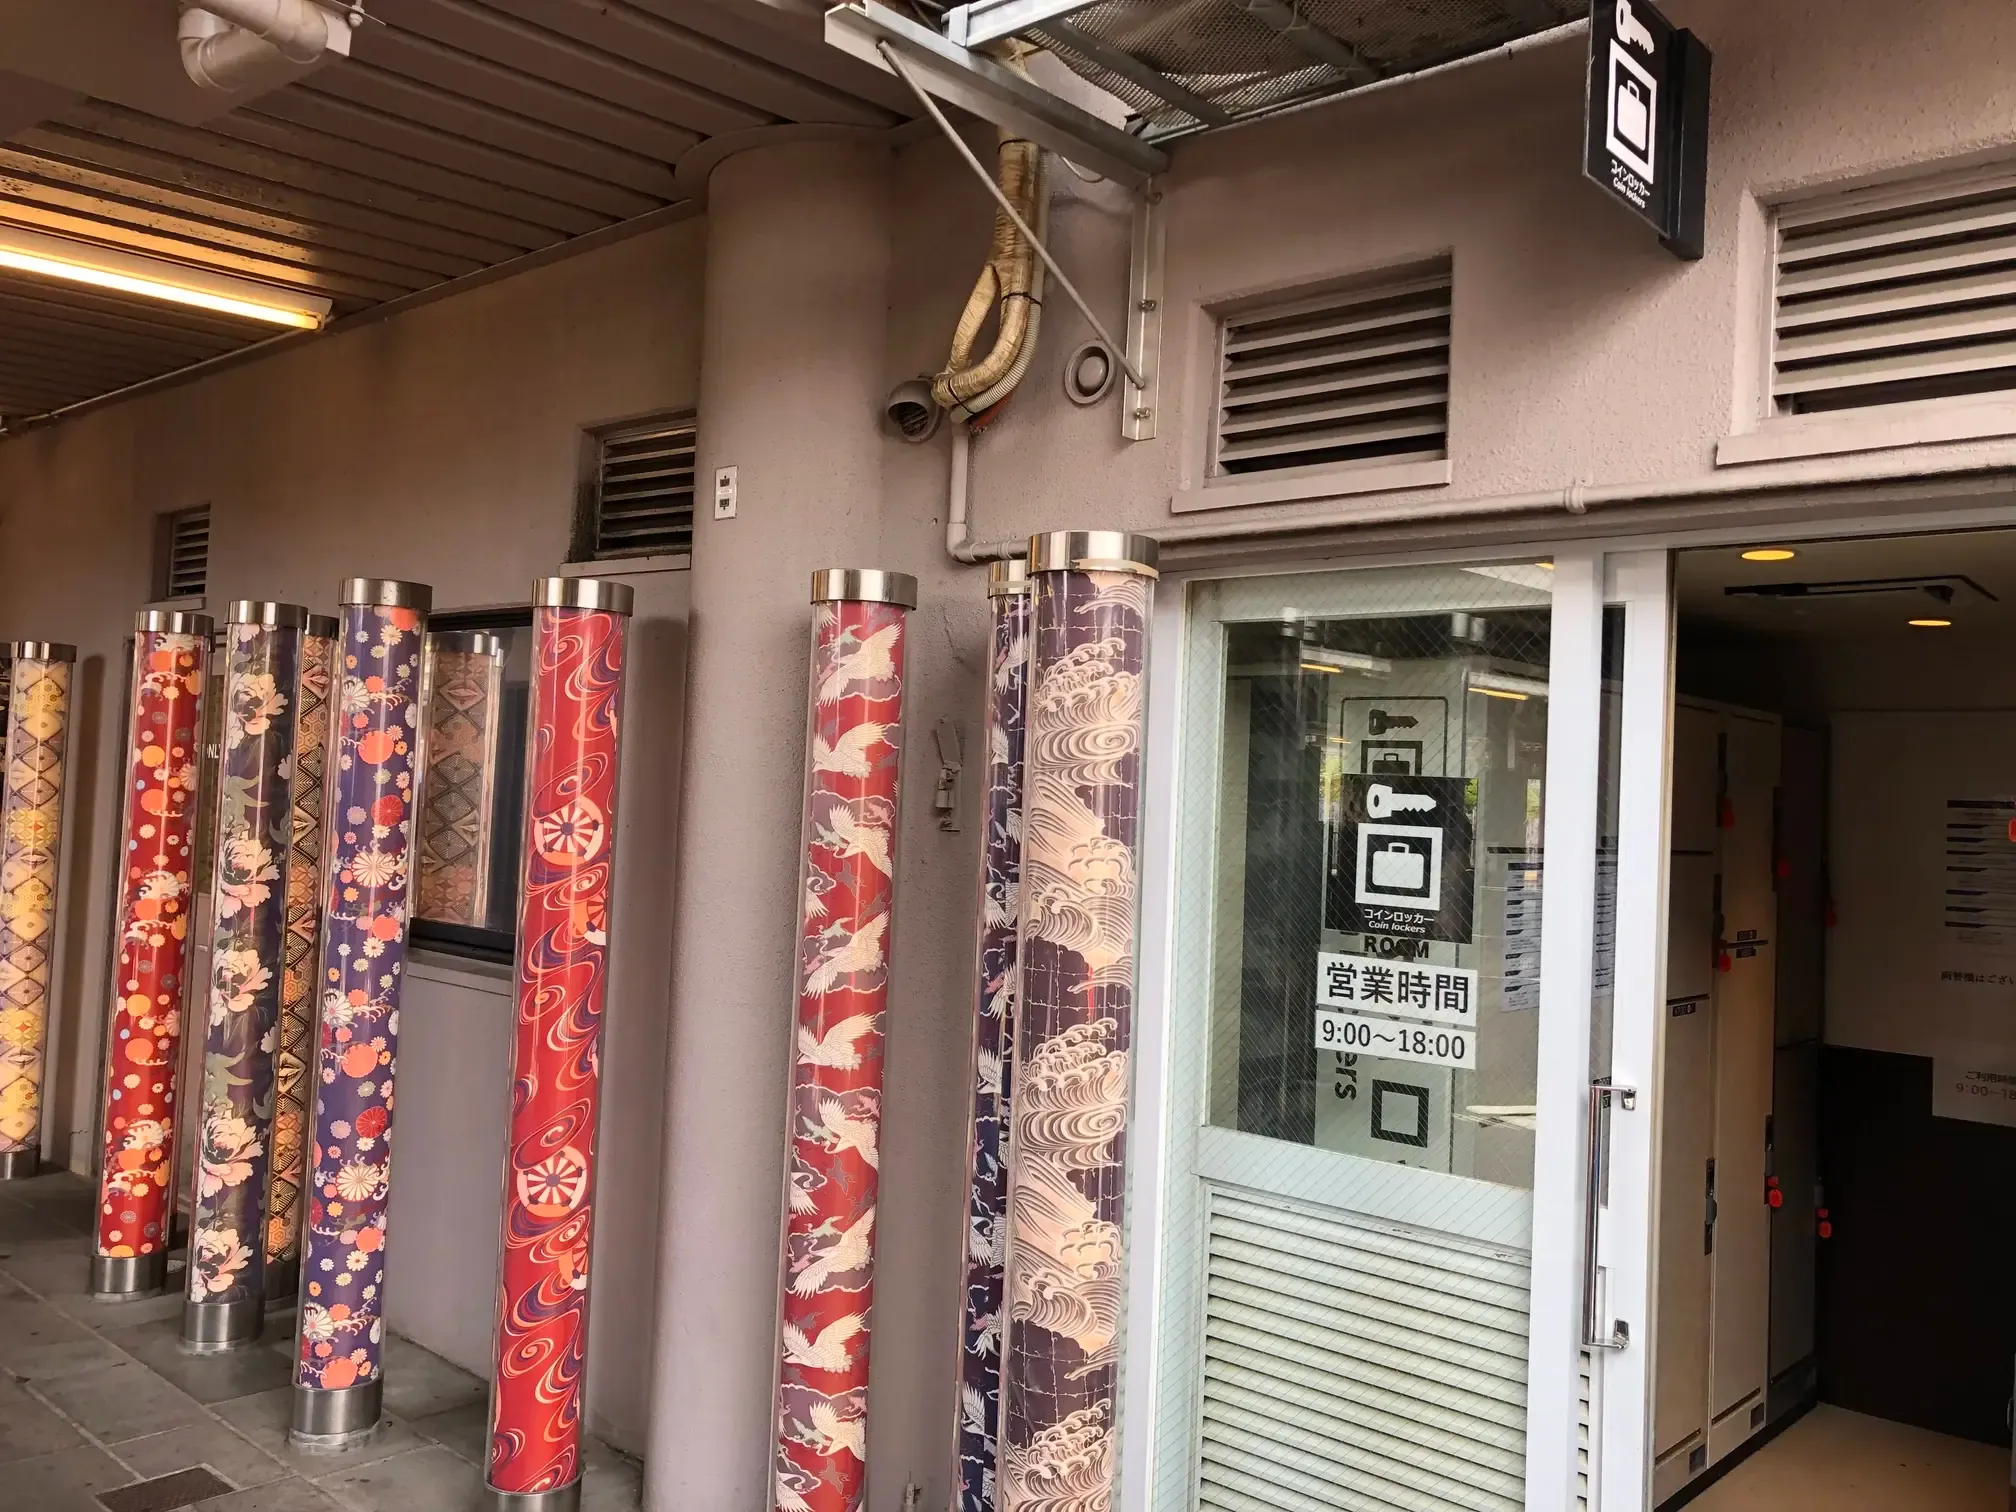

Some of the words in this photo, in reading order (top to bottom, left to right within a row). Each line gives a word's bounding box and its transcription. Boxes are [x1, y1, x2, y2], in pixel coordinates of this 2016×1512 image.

[1611, 158, 1650, 197] コインロッカー
[1613, 177, 1626, 194] Coin
[1626, 187, 1646, 209] lockers
[1364, 908, 1435, 925] コインロッカー
[1368, 920, 1390, 930] Coin
[1391, 921, 1426, 934] lockers
[1326, 961, 1470, 1014] 営業時間
